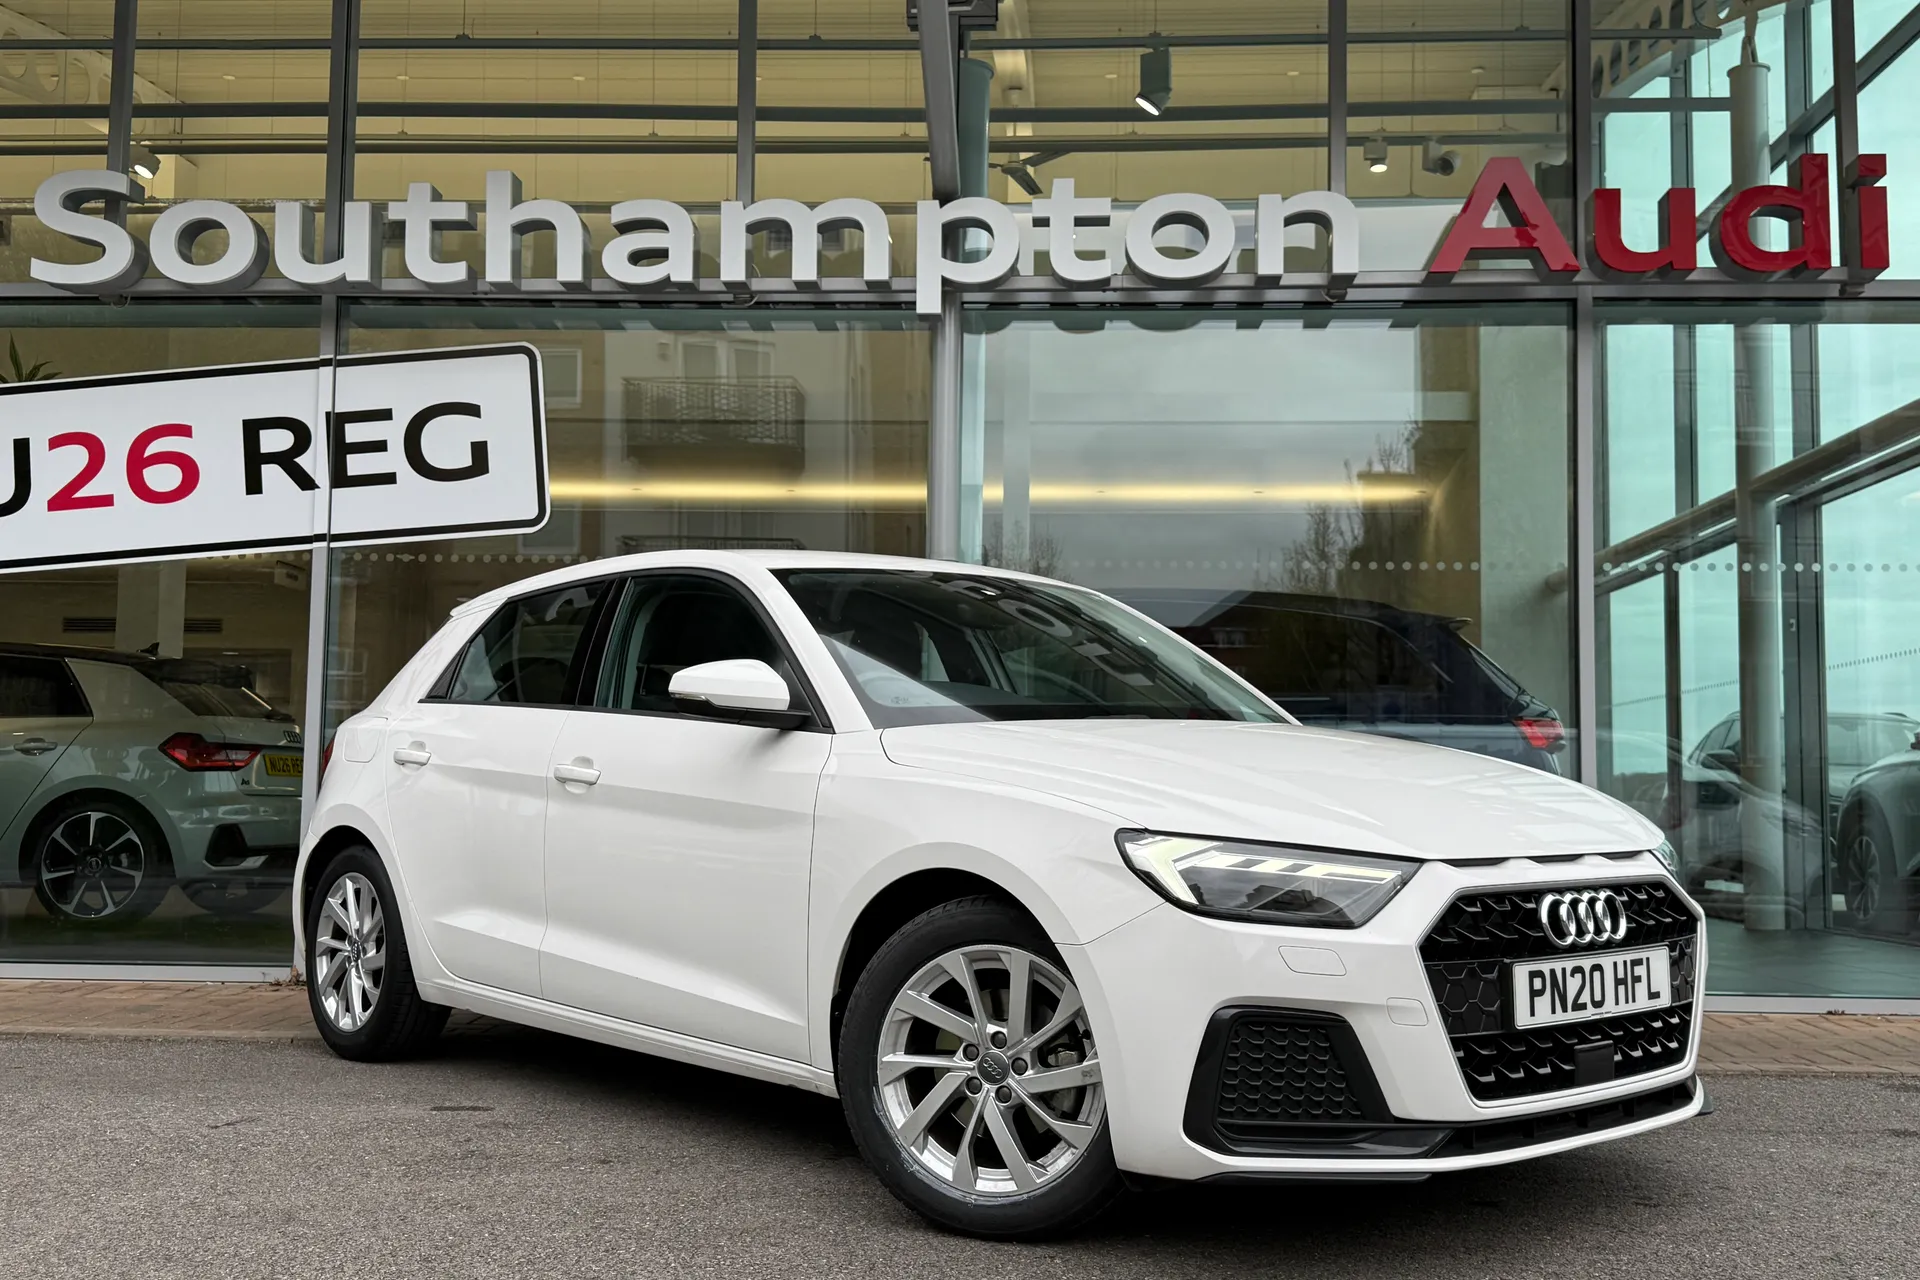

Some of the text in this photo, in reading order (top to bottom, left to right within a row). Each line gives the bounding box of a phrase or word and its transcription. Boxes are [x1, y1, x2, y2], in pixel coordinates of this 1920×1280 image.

[30, 153, 1890, 315] Southampton Audi
[242, 402, 490, 496] REG
[1528, 957, 1661, 1018] PN20 HFL
